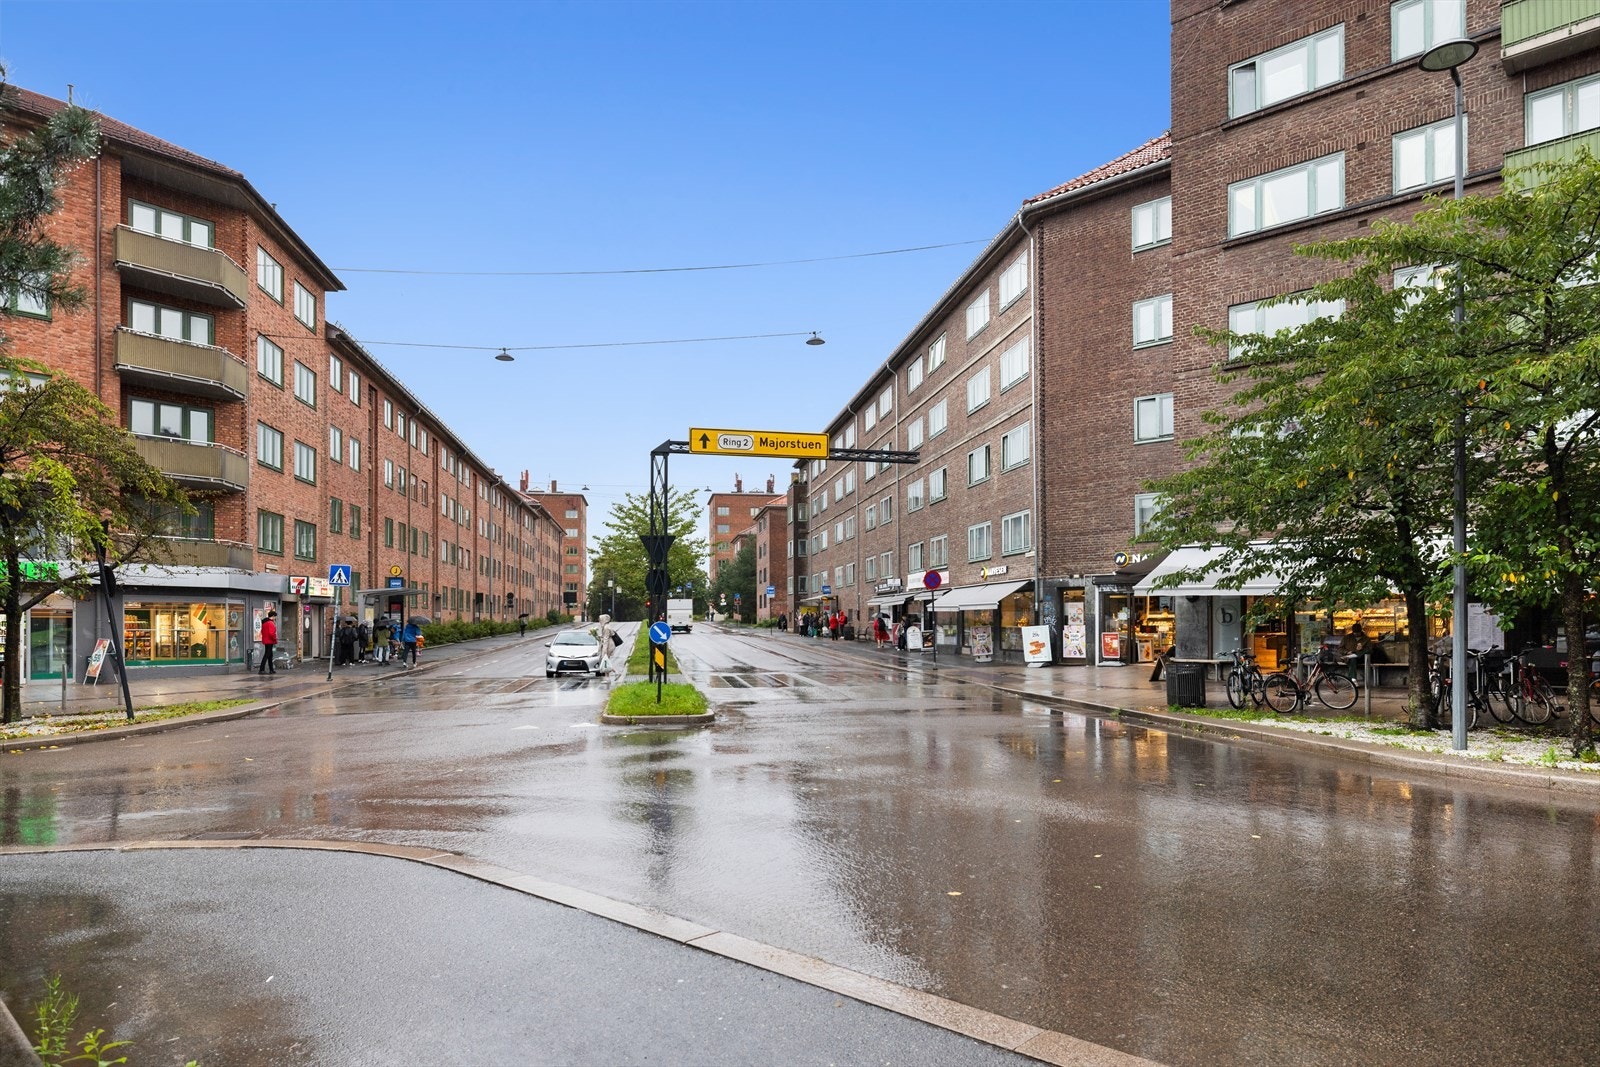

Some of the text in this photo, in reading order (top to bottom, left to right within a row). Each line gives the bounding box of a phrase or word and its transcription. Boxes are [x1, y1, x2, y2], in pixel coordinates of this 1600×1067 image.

[722, 437, 822, 451] Ring 2 Majorstuen
[1220, 607, 1233, 624] b
